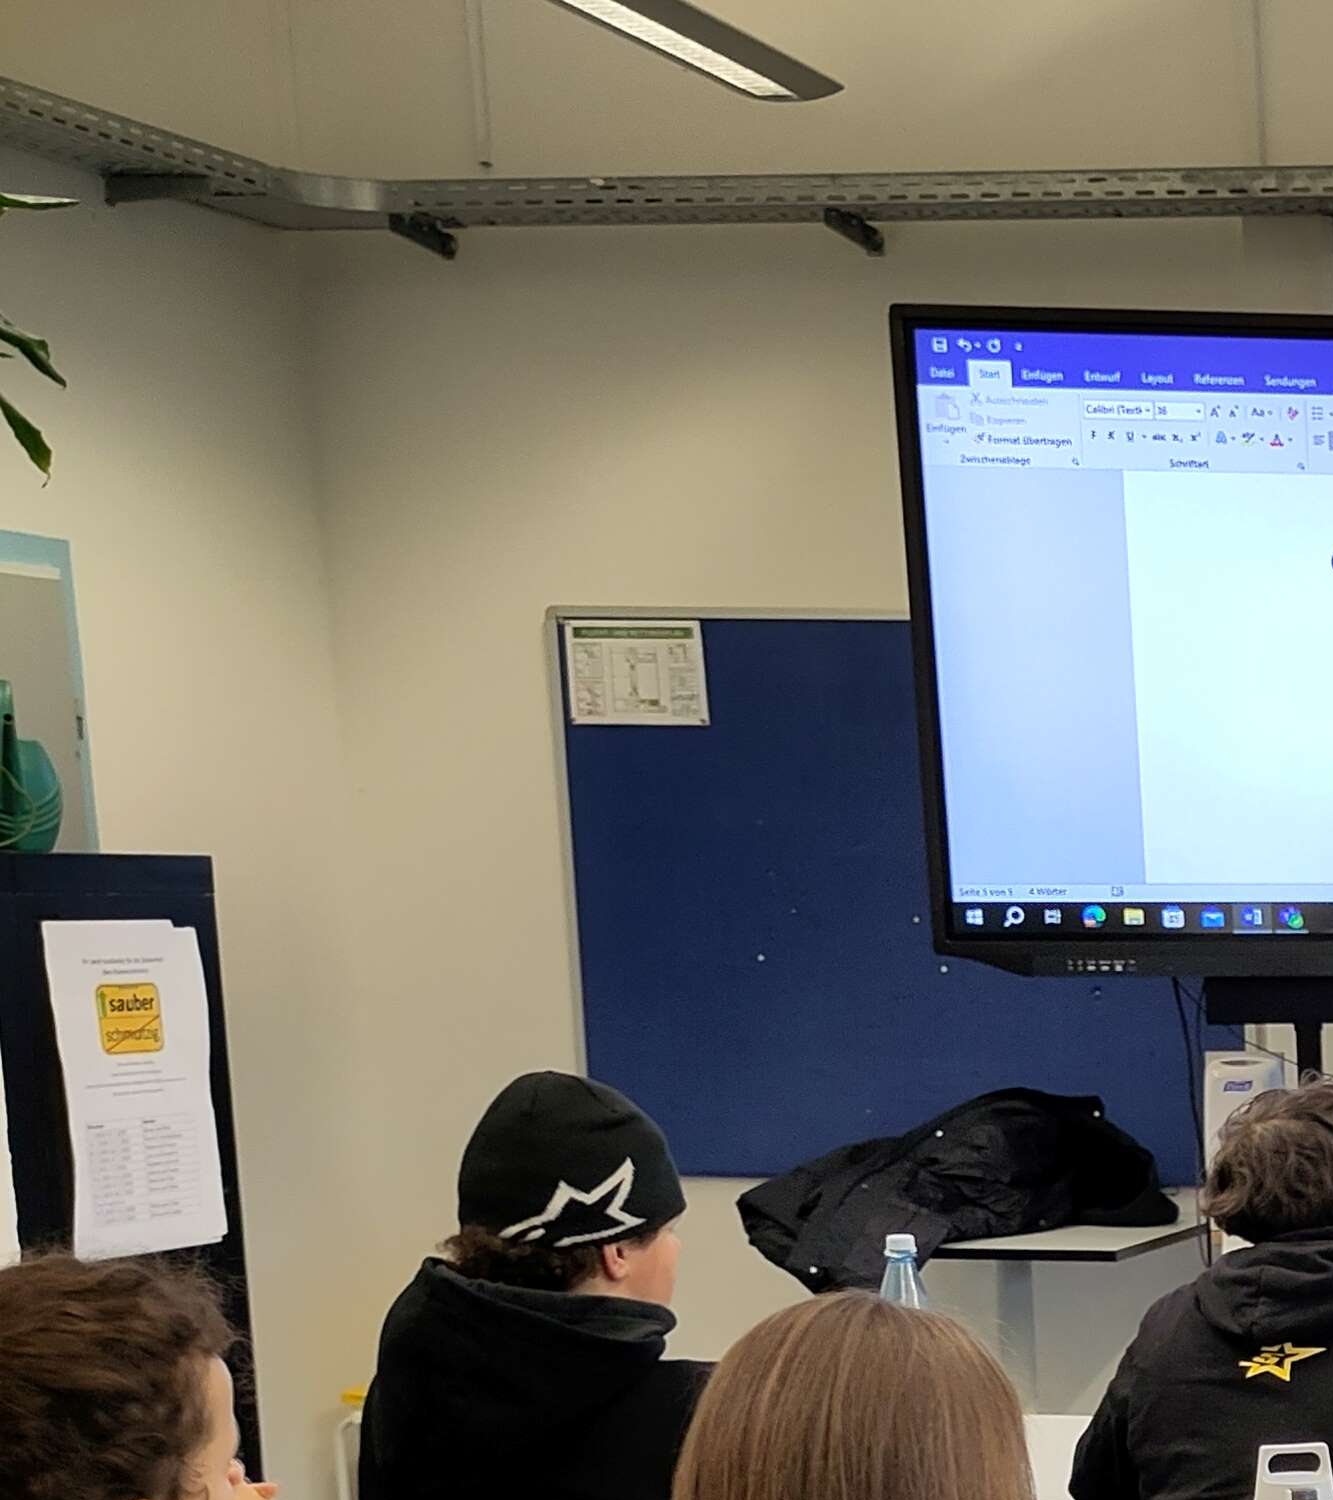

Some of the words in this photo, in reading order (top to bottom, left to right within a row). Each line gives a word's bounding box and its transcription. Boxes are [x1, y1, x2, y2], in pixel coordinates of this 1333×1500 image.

[930, 367, 955, 379] Datei
[979, 368, 1000, 378] Start
[1021, 370, 1064, 383] Einfügen
[1083, 371, 1121, 383] Entwurf
[1141, 373, 1174, 385] Layout
[1193, 373, 1245, 386] Referenzen
[1263, 374, 1317, 389] Sendungen
[1086, 404, 1114, 414] Calibri
[926, 424, 967, 435] Einfügen
[988, 436, 1020, 446] Format
[1023, 436, 1073, 449] übertragen
[960, 455, 1031, 466] Zwischenablage
[1169, 458, 1209, 470] Schriftart
[109, 993, 154, 1012] sauber
